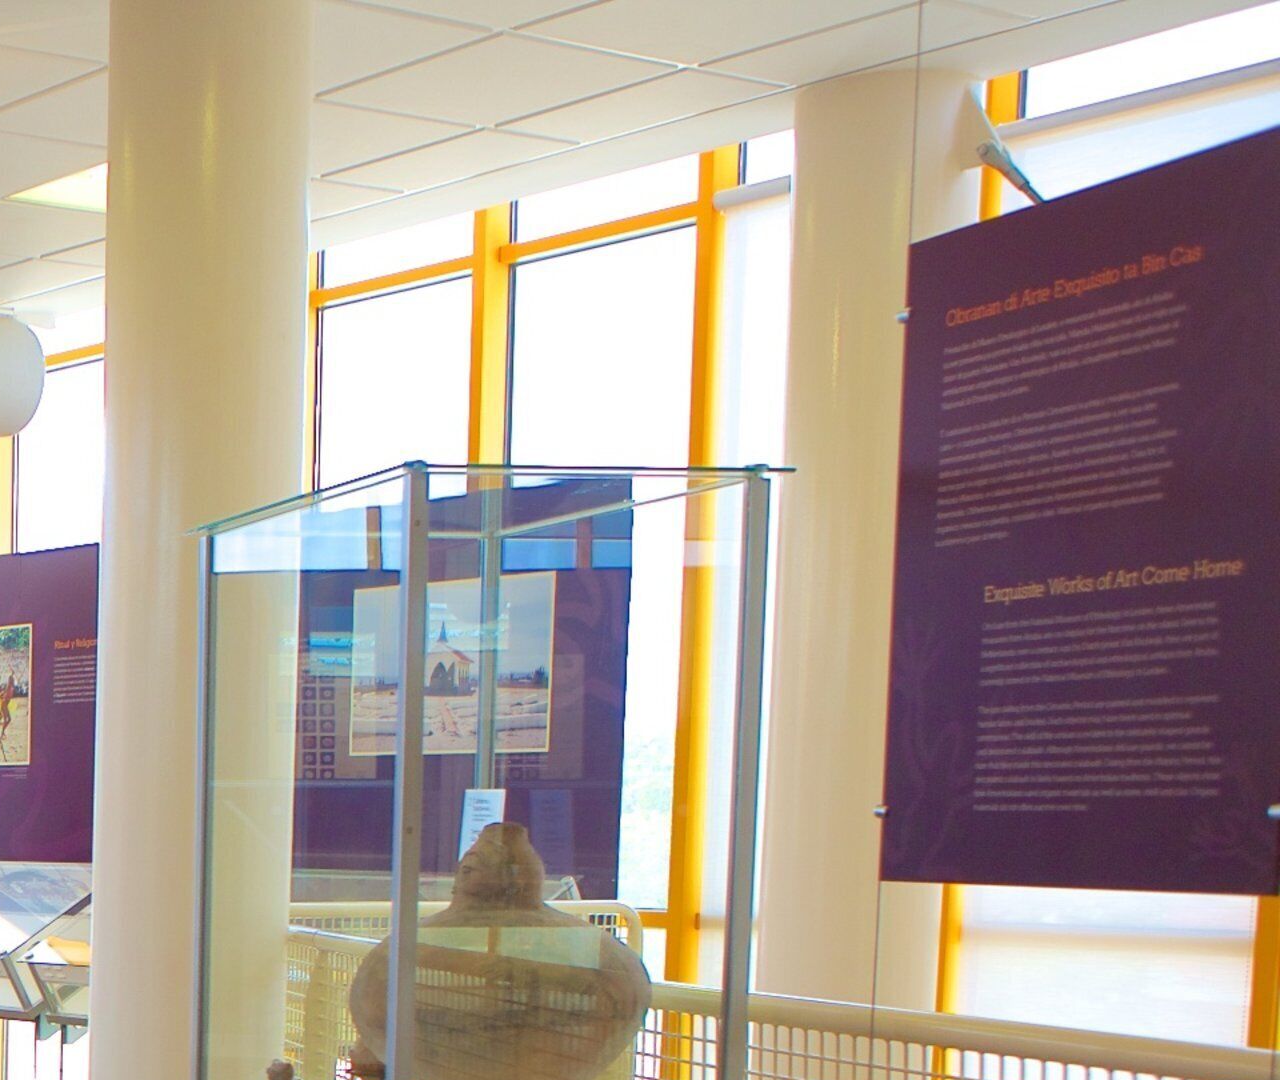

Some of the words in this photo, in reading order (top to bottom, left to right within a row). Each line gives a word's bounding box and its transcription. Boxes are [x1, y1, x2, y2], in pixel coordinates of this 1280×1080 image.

[983, 580, 1045, 605] Exquisite
[1047, 575, 1095, 595] Works
[1096, 570, 1115, 591] of
[1114, 569, 1140, 589] Art
[1141, 565, 1191, 586] Come
[1192, 559, 1245, 580] Home
